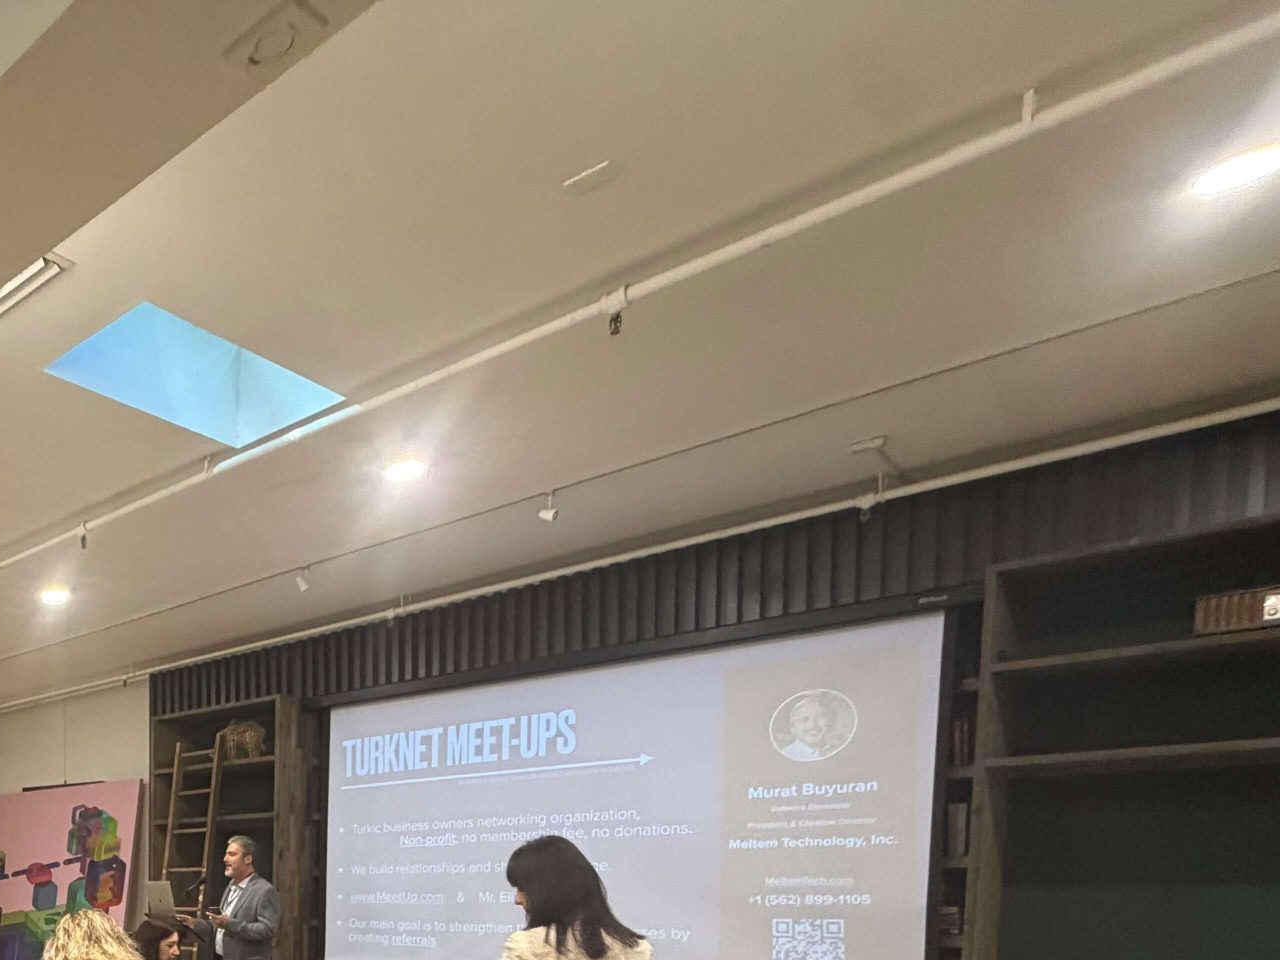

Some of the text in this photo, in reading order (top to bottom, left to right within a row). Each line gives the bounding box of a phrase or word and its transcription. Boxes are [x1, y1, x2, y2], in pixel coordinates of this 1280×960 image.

[342, 727, 443, 777] TURKNET
[446, 709, 577, 767] MEET-UPS
[748, 781, 878, 799] Murat Buyuran
[352, 809, 640, 834] Turkic business owners networking organization,
[462, 833, 477, 843] no
[592, 827, 610, 839] no
[614, 823, 693, 838] donations.
[729, 834, 899, 850] Meltem Technology, Inc.
[351, 865, 366, 875] We
[369, 864, 393, 875] build
[396, 862, 465, 875] relationships
[469, 862, 491, 874] and
[350, 890, 444, 905] www.MeetUp.com
[456, 891, 465, 903] &
[479, 891, 495, 903] Mr.
[749, 894, 871, 907] +1 (562) 899-1105
[349, 917, 368, 929] Our
[370, 918, 395, 930] main
[398, 919, 420, 933] goal
[423, 921, 432, 931] is
[435, 920, 446, 931] to
[449, 921, 513, 936] strengthen
[671, 927, 691, 942] by
[349, 933, 437, 947] creating referrals
